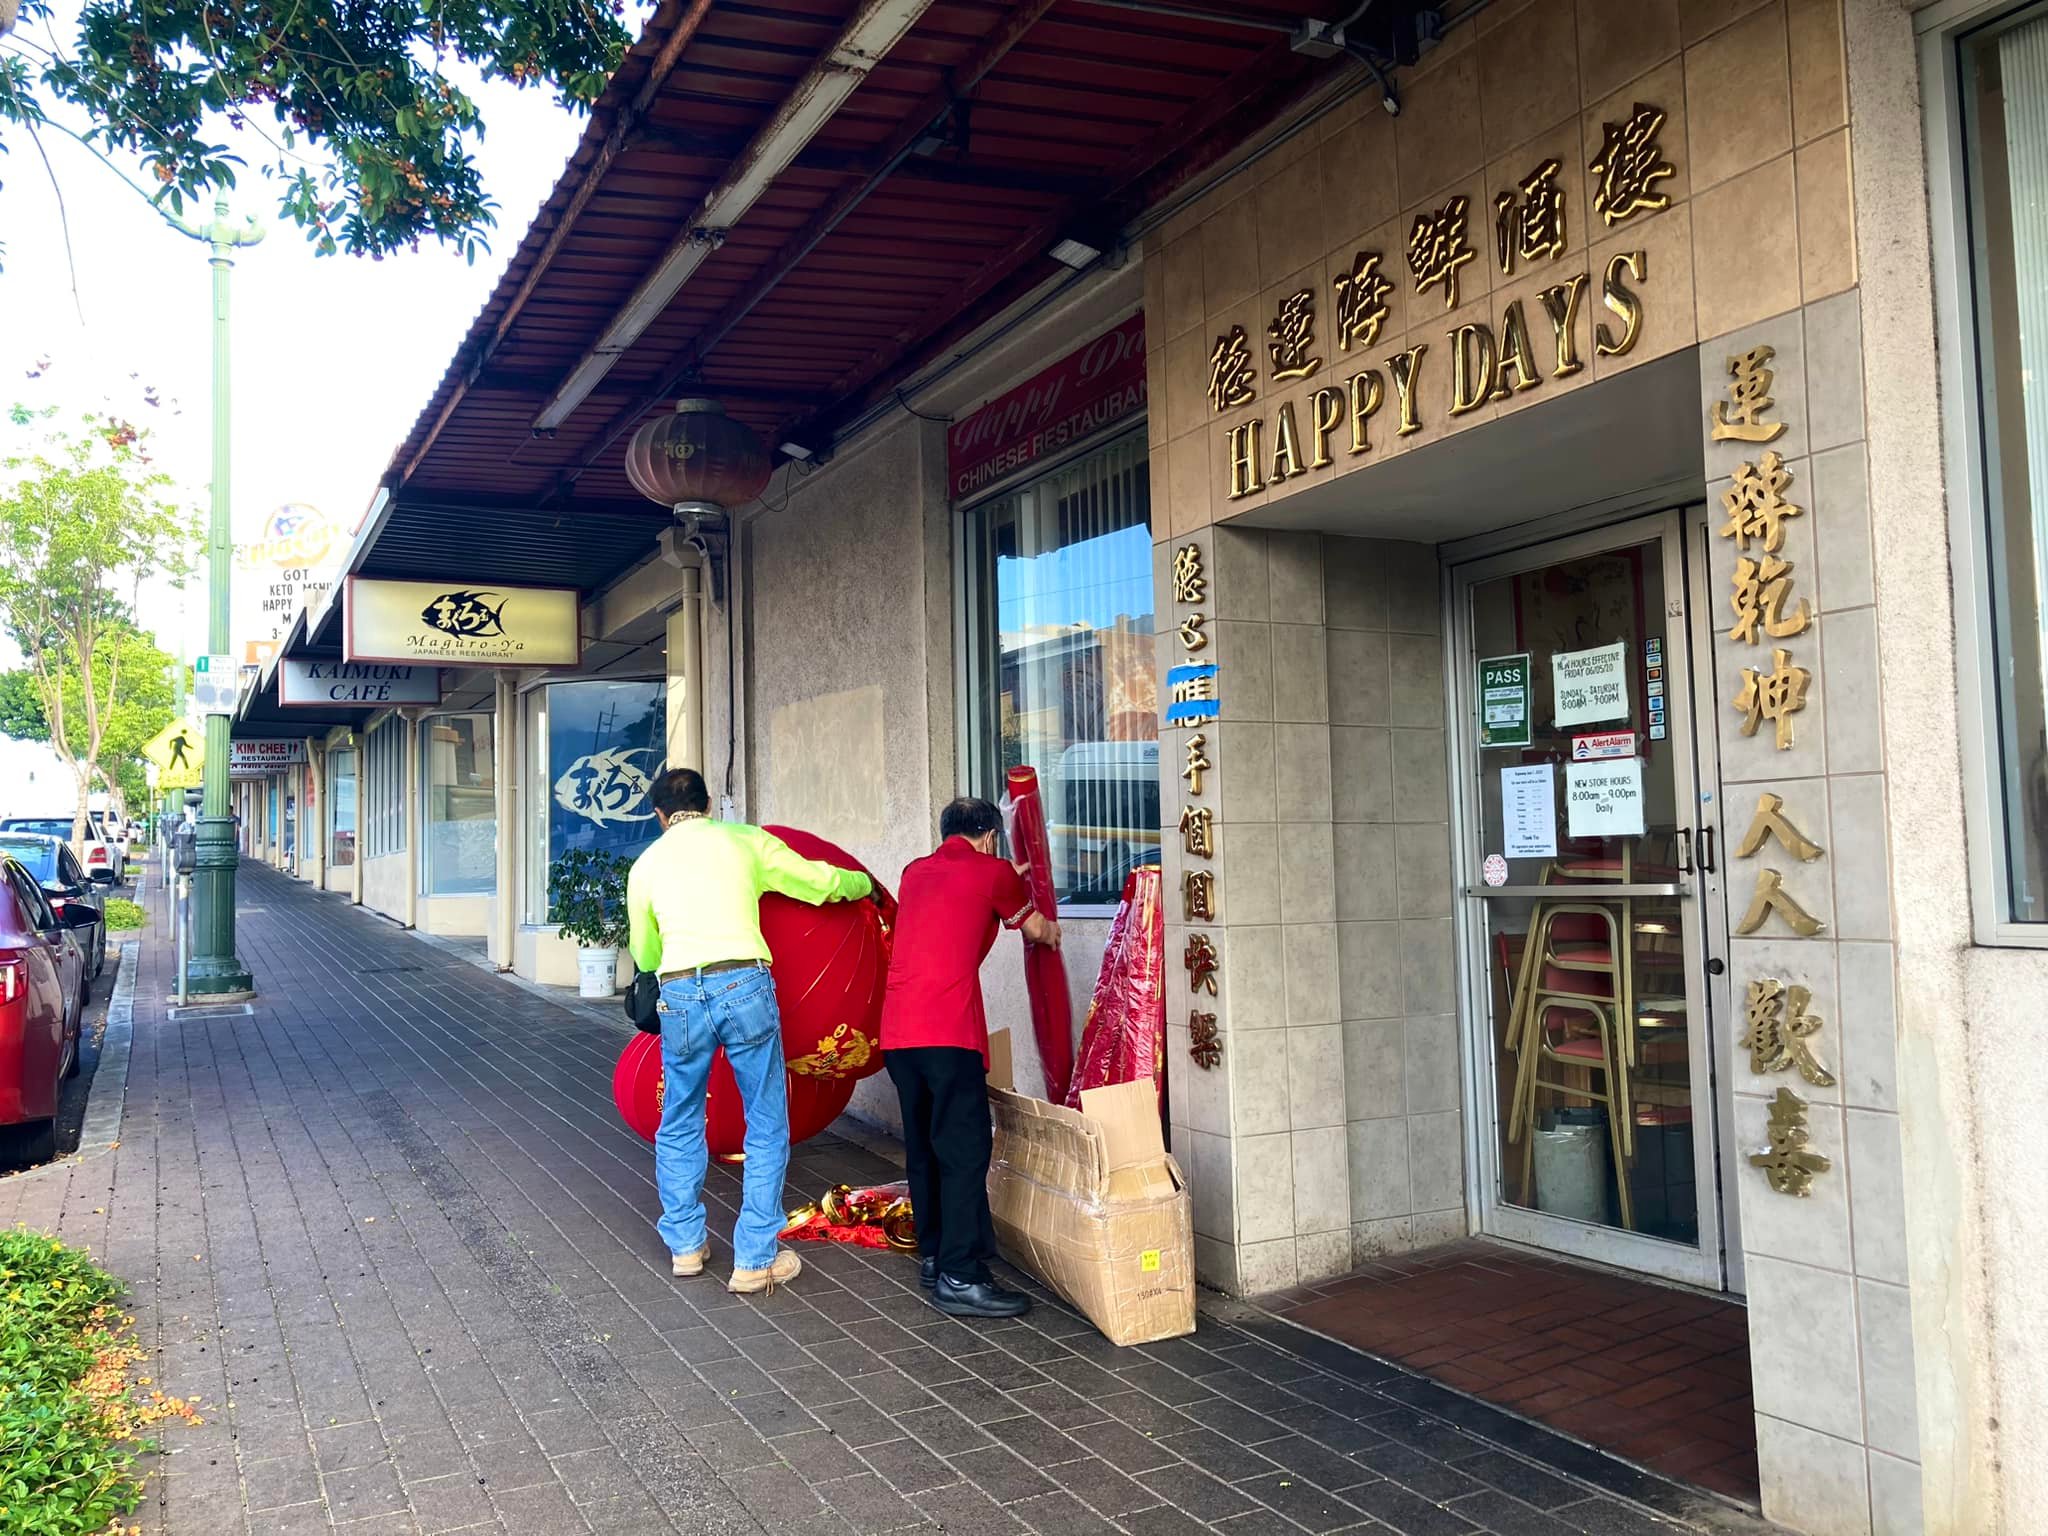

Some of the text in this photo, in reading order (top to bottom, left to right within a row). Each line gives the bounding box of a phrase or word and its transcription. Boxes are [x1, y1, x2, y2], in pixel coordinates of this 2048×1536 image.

[1225, 248, 1649, 502] HAPPY DAYS
[957, 441, 1029, 494] CHINESE
[283, 569, 309, 582] GOT
[269, 584, 294, 597] KETO
[262, 598, 293, 612] HAPPY
[407, 635, 525, 652] Maguro-Ya
[413, 648, 514, 659] JAPANESE RESTAURANT
[1570, 656, 1591, 669] HOURS
[1591, 652, 1620, 666] EFFECTIVE
[308, 662, 413, 681] KAIMUKI
[1486, 668, 1521, 685] PASS
[1564, 668, 1585, 680] FRIDAY
[329, 681, 392, 701] CAFÉ
[1560, 688, 1583, 700] SUNDAY
[1590, 682, 1620, 695] SATURDAY
[236, 743, 256, 754] KIM
[259, 743, 286, 754] CHEE
[1574, 779, 1587, 789] NEW
[1588, 777, 1608, 788] STORE
[1595, 803, 1614, 815] Daily
